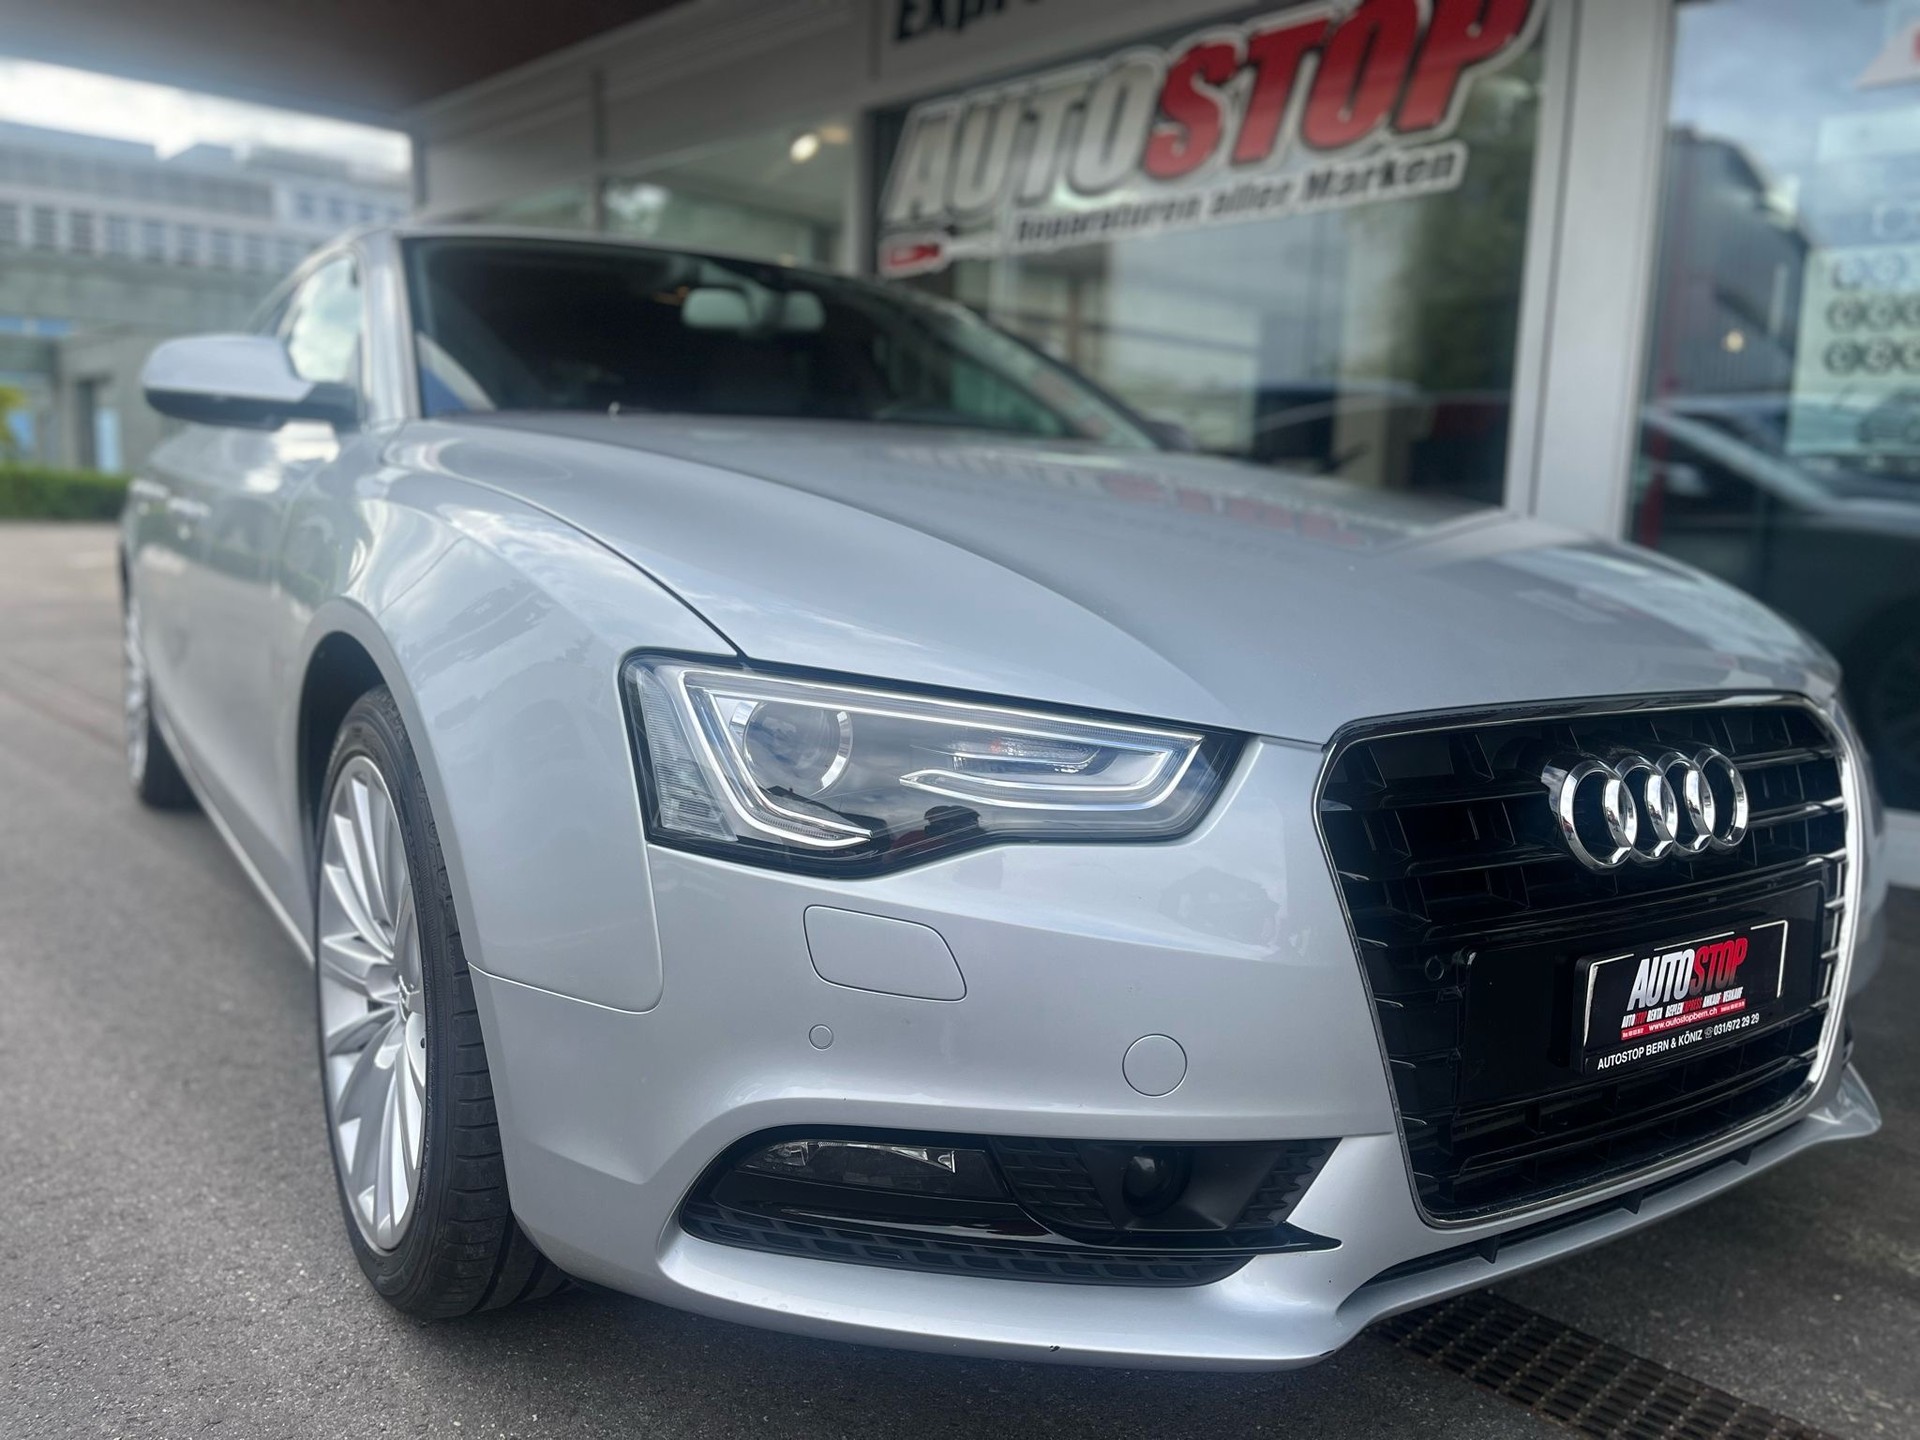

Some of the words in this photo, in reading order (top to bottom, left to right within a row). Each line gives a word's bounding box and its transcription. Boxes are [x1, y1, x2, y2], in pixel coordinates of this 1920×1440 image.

[886, 0, 1532, 222] AUTOSTOP
[1305, 150, 1457, 201] Marken
[1627, 937, 1748, 1011] AUTOSTOP
[1597, 1048, 1644, 1070] AUTOSTOP
[1646, 1039, 1669, 1056] BERN
[1671, 1037, 1677, 1048] &
[1678, 1030, 1703, 1046] KÖNIZ
[1713, 1019, 1741, 1036] 031/972
[1742, 1016, 1751, 1027] 29
[1751, 1013, 1760, 1024] 29
